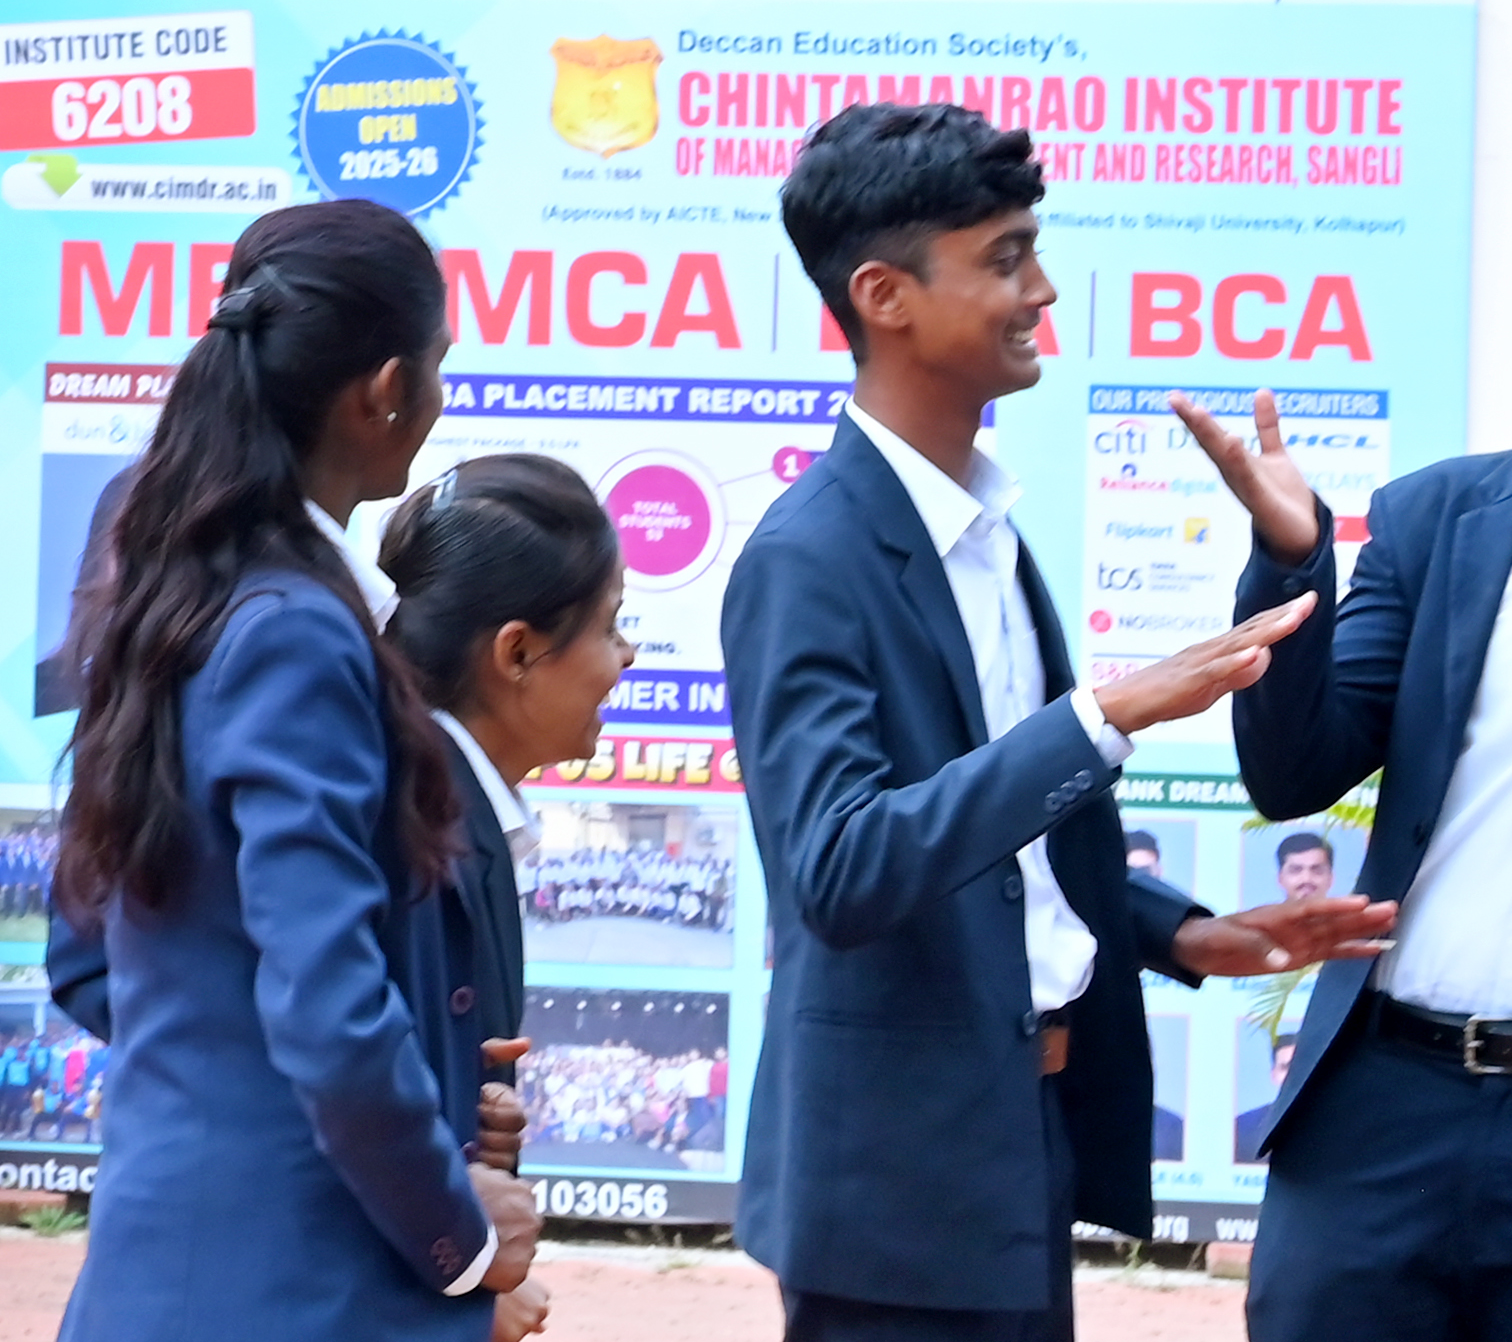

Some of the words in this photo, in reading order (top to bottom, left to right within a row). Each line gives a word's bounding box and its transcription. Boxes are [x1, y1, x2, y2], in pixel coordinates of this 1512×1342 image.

[5, 30, 145, 65] INSTITUTE
[156, 25, 228, 55] CODE
[677, 29, 782, 55] Deccan
[793, 31, 938, 57] Education
[949, 32, 1088, 63] Society's,
[51, 74, 193, 142] 6208
[315, 77, 459, 113] ADMISSIONS
[1124, 77, 1403, 136] INSTITUTE
[359, 114, 417, 146] OPEN
[339, 147, 439, 181] 2025-26
[676, 136, 705, 176] OF
[1093, 142, 1145, 183] AND
[1154, 142, 1299, 188] RESEARCH,
[1307, 143, 1403, 187] SANGLI
[90, 175, 278, 202] www.cimdr.ac.in
[541, 204, 634, 224] (Approved
[639, 205, 660, 225] by
[733, 208, 772, 224] New
[1118, 213, 1138, 230] to
[1143, 213, 1205, 235] Shivaji
[1209, 213, 1305, 237] University,
[442, 249, 743, 350] MCA
[1128, 272, 1374, 362] BCA
[48, 372, 132, 399] DREAM
[483, 382, 681, 413] PLACEMENT
[687, 386, 819, 417] REPORT
[1091, 388, 1133, 412] OUR
[1136, 389, 1256, 415] PRETIGIOUS
[1276, 392, 1380, 417] ECRUITERS
[1287, 433, 1381, 450] HCL
[622, 740, 715, 785] LIFE
